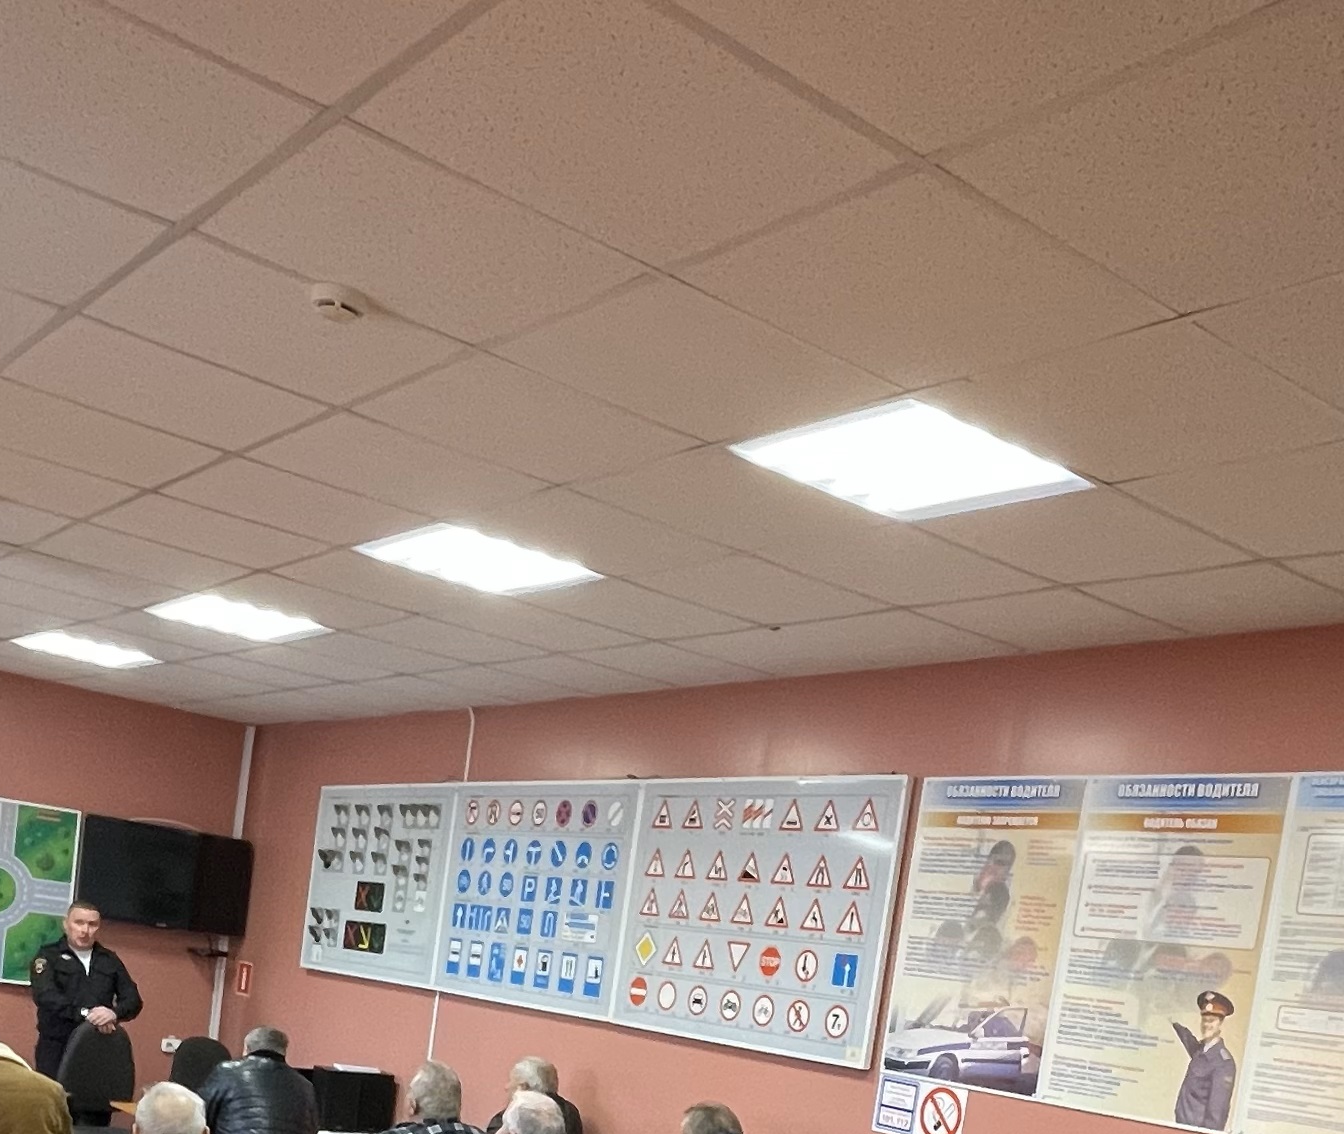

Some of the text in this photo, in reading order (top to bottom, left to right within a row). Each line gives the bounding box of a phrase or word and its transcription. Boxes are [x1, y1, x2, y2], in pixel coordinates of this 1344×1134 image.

[946, 784, 1061, 798] ОБЯЗАННОСТИ ВОДИТЕЛЯ
[1117, 782, 1260, 799] ОБЯЗАННОСТИ ВОДИТЕЛЯ
